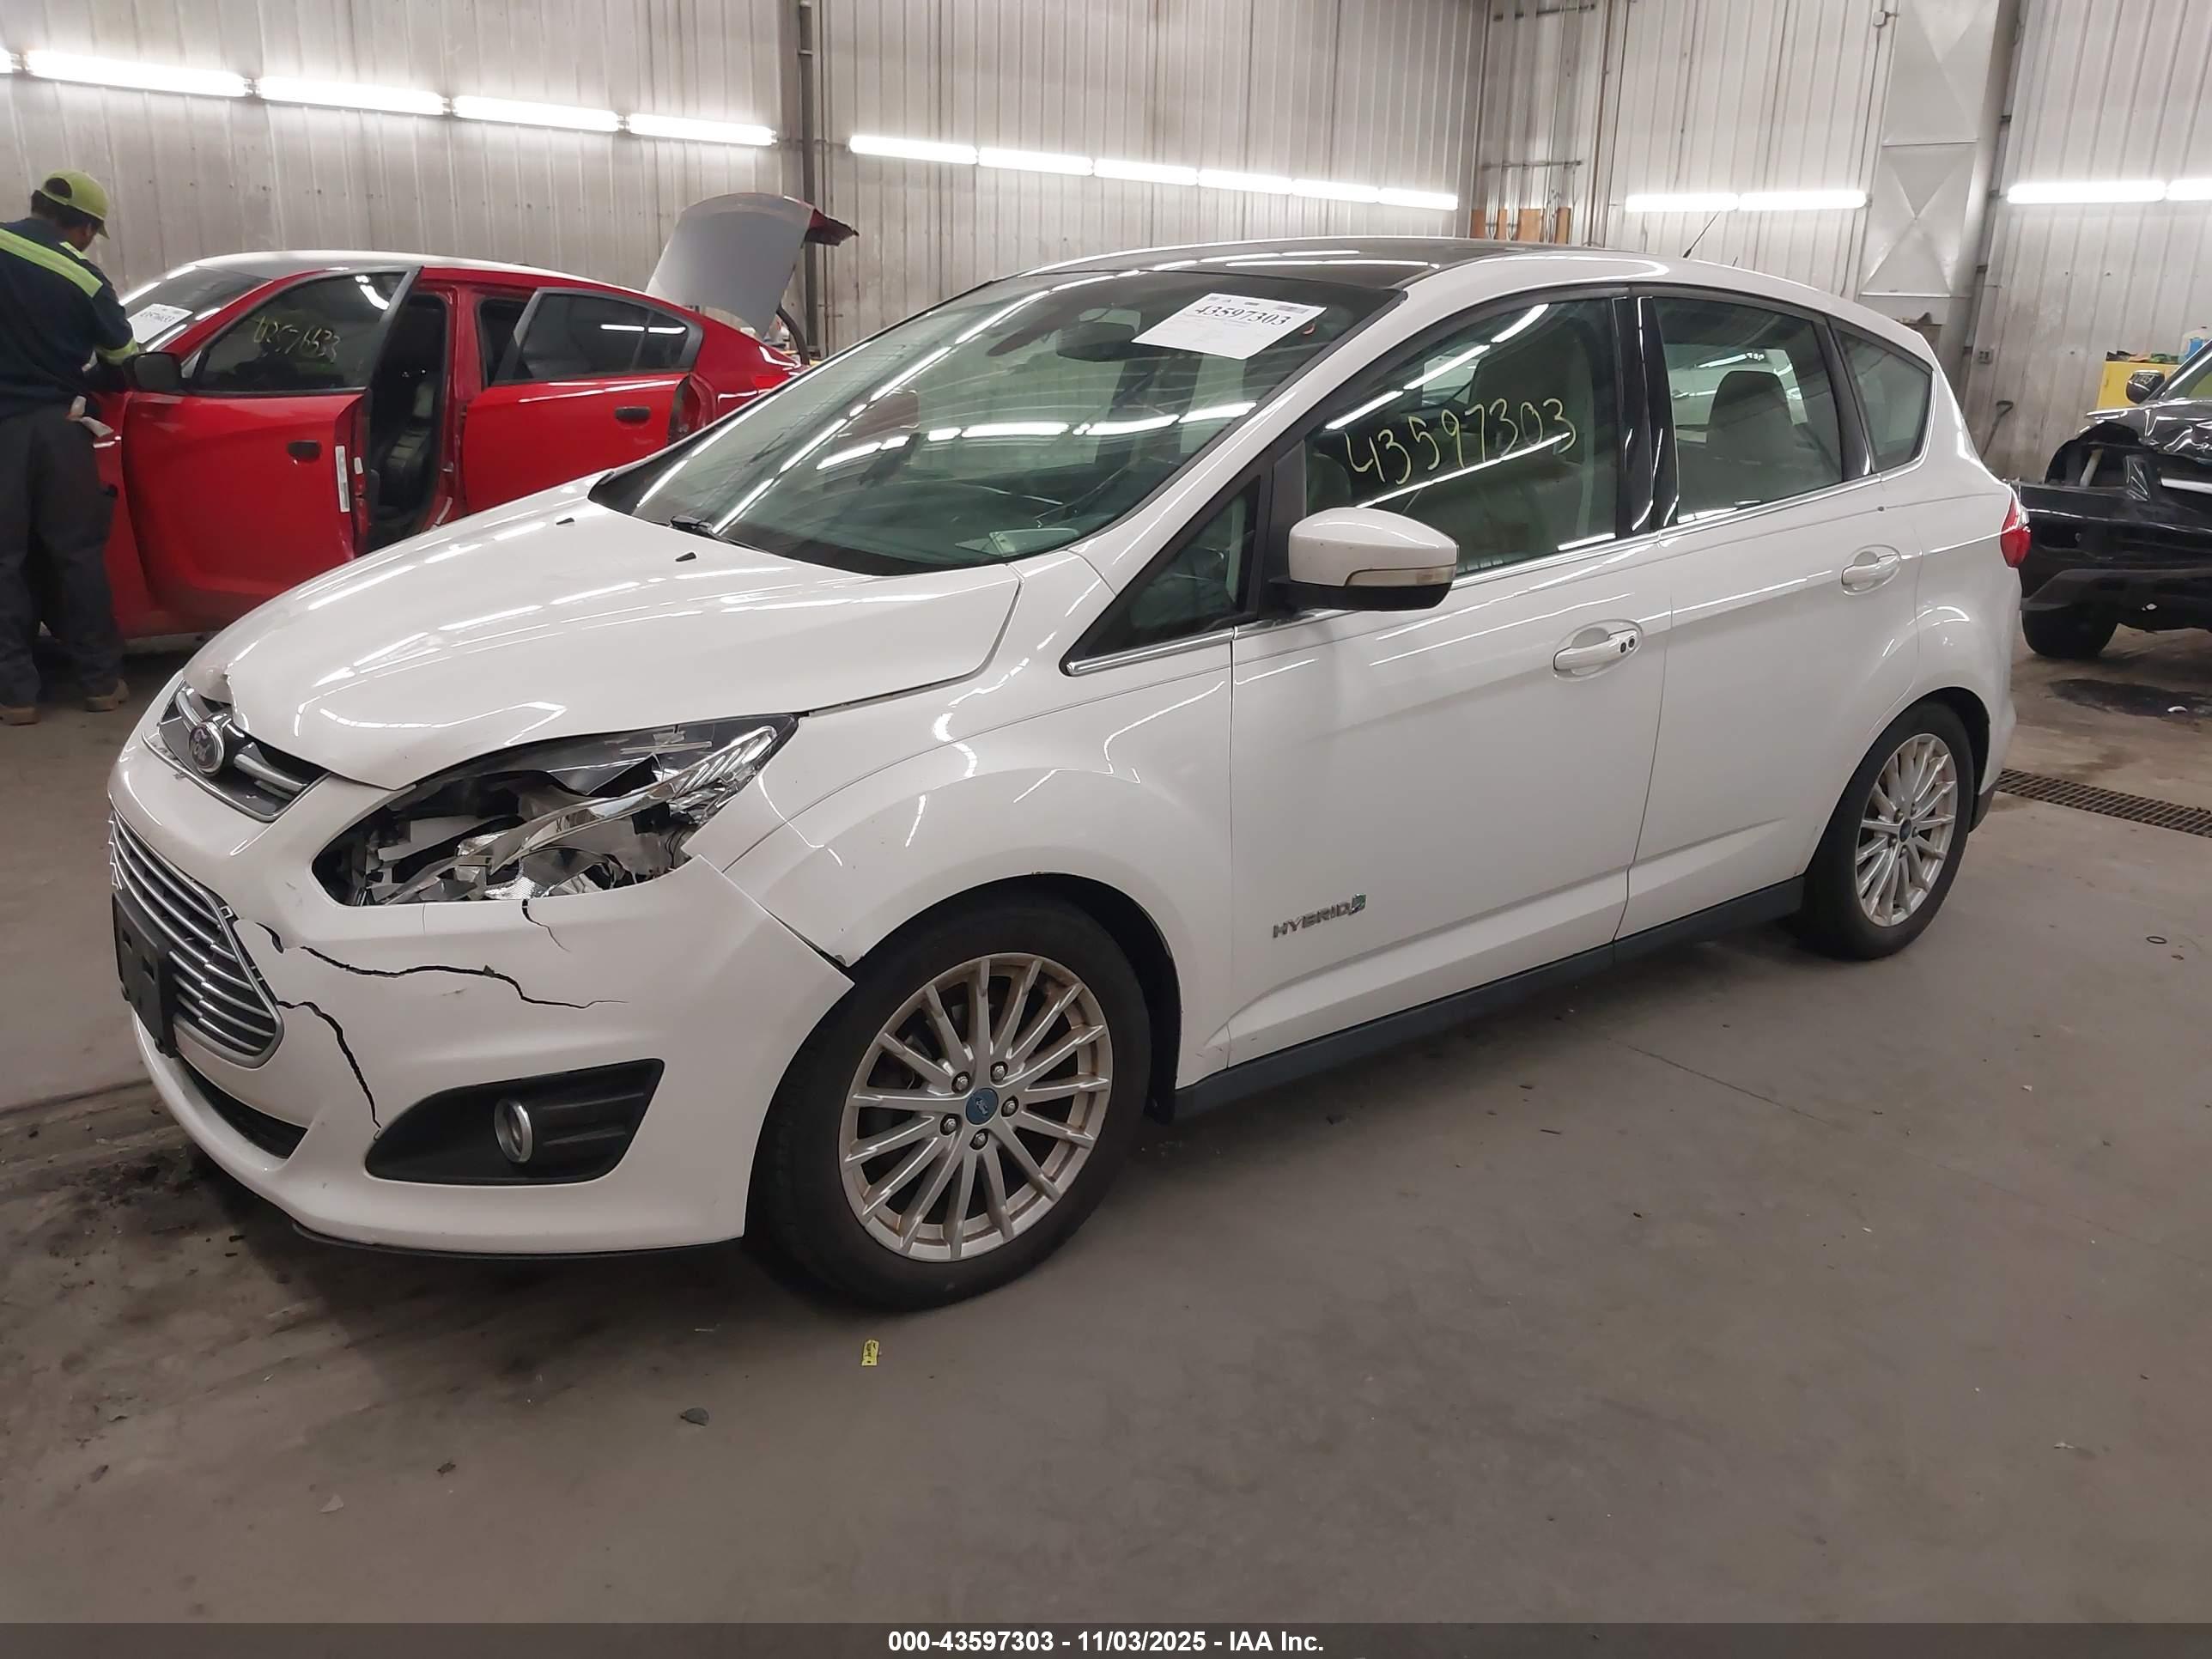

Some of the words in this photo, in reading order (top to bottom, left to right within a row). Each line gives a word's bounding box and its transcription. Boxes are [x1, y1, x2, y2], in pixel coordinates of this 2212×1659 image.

[1194, 304, 1292, 326] 43597303
[1344, 398, 1577, 485] 43597303
[1272, 901, 1352, 939] HYBRID
